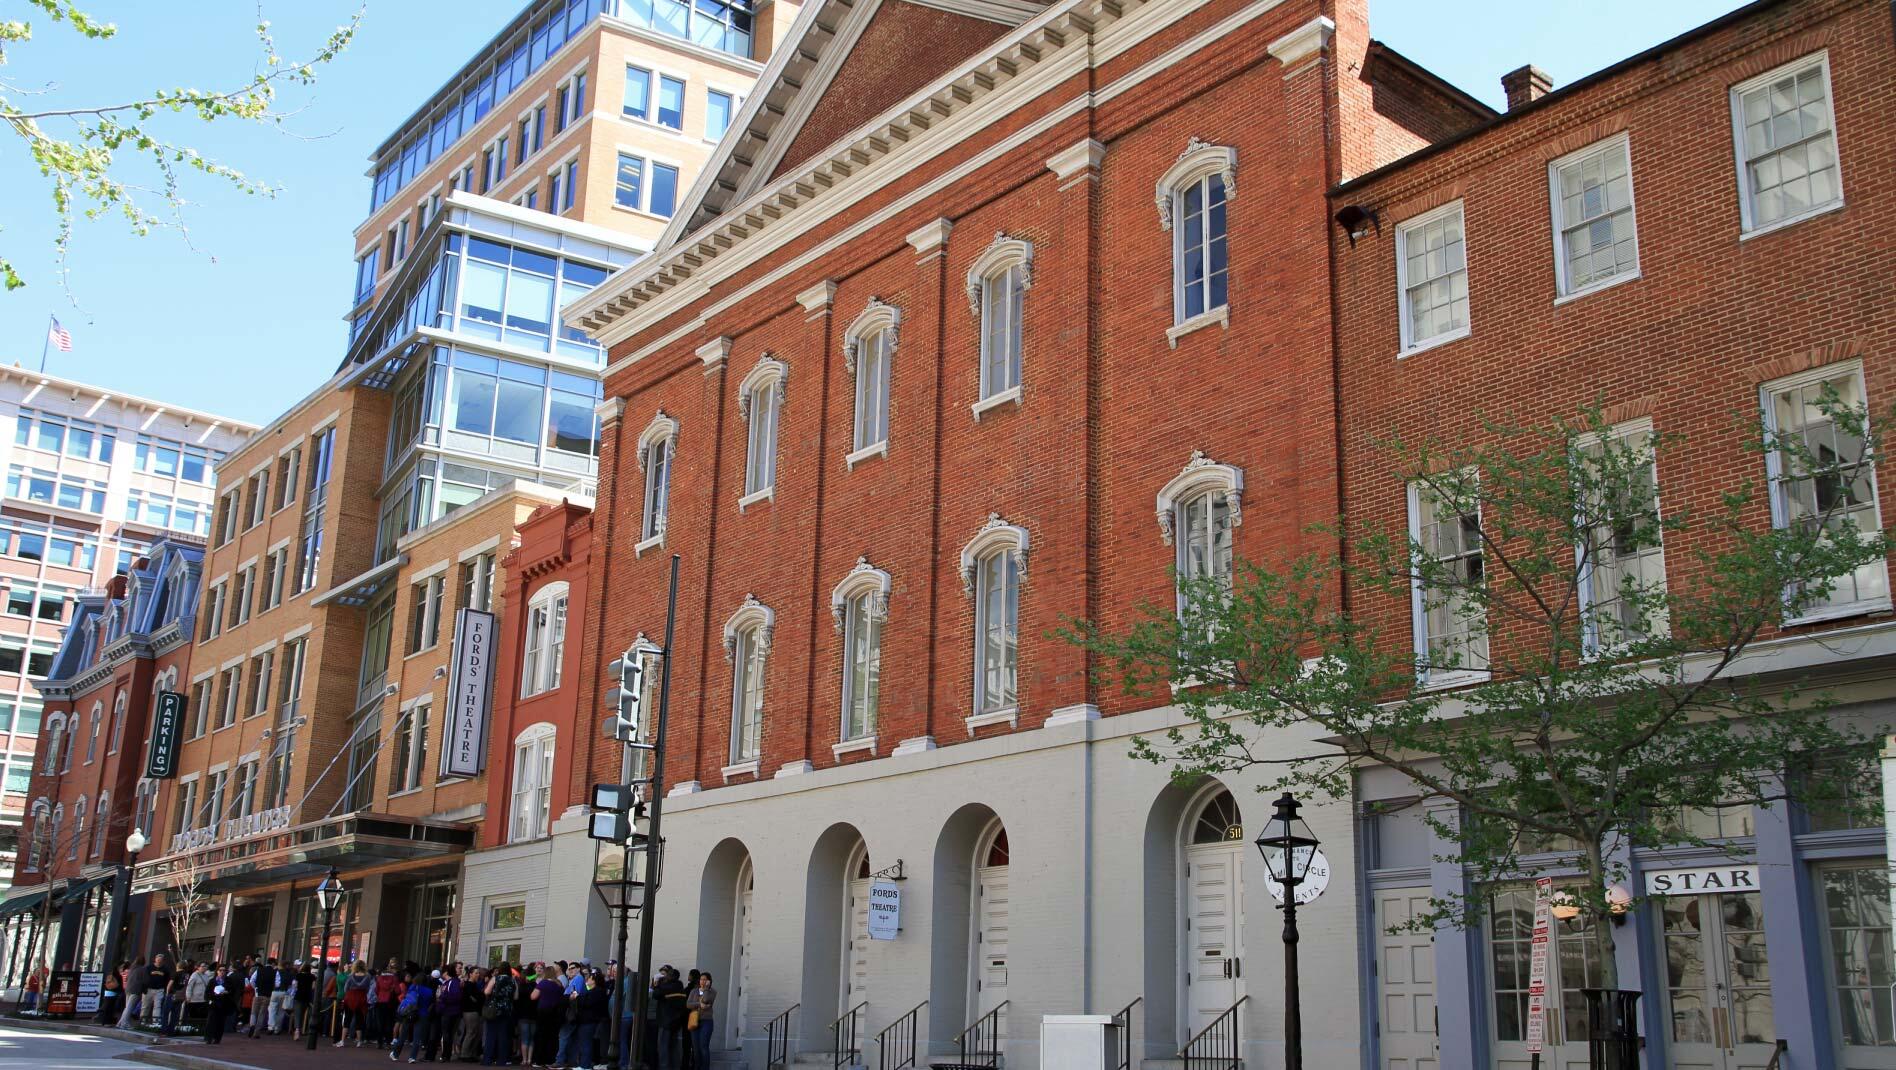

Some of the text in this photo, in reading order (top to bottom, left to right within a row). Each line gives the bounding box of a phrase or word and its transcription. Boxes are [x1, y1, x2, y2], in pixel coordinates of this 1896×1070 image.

[460, 622, 483, 763] FORD'S THEATRE
[156, 698, 174, 765] PARKING
[1229, 827, 1241, 838] 511
[1654, 870, 1753, 891] STAR
[871, 903, 898, 912] THEATRE
